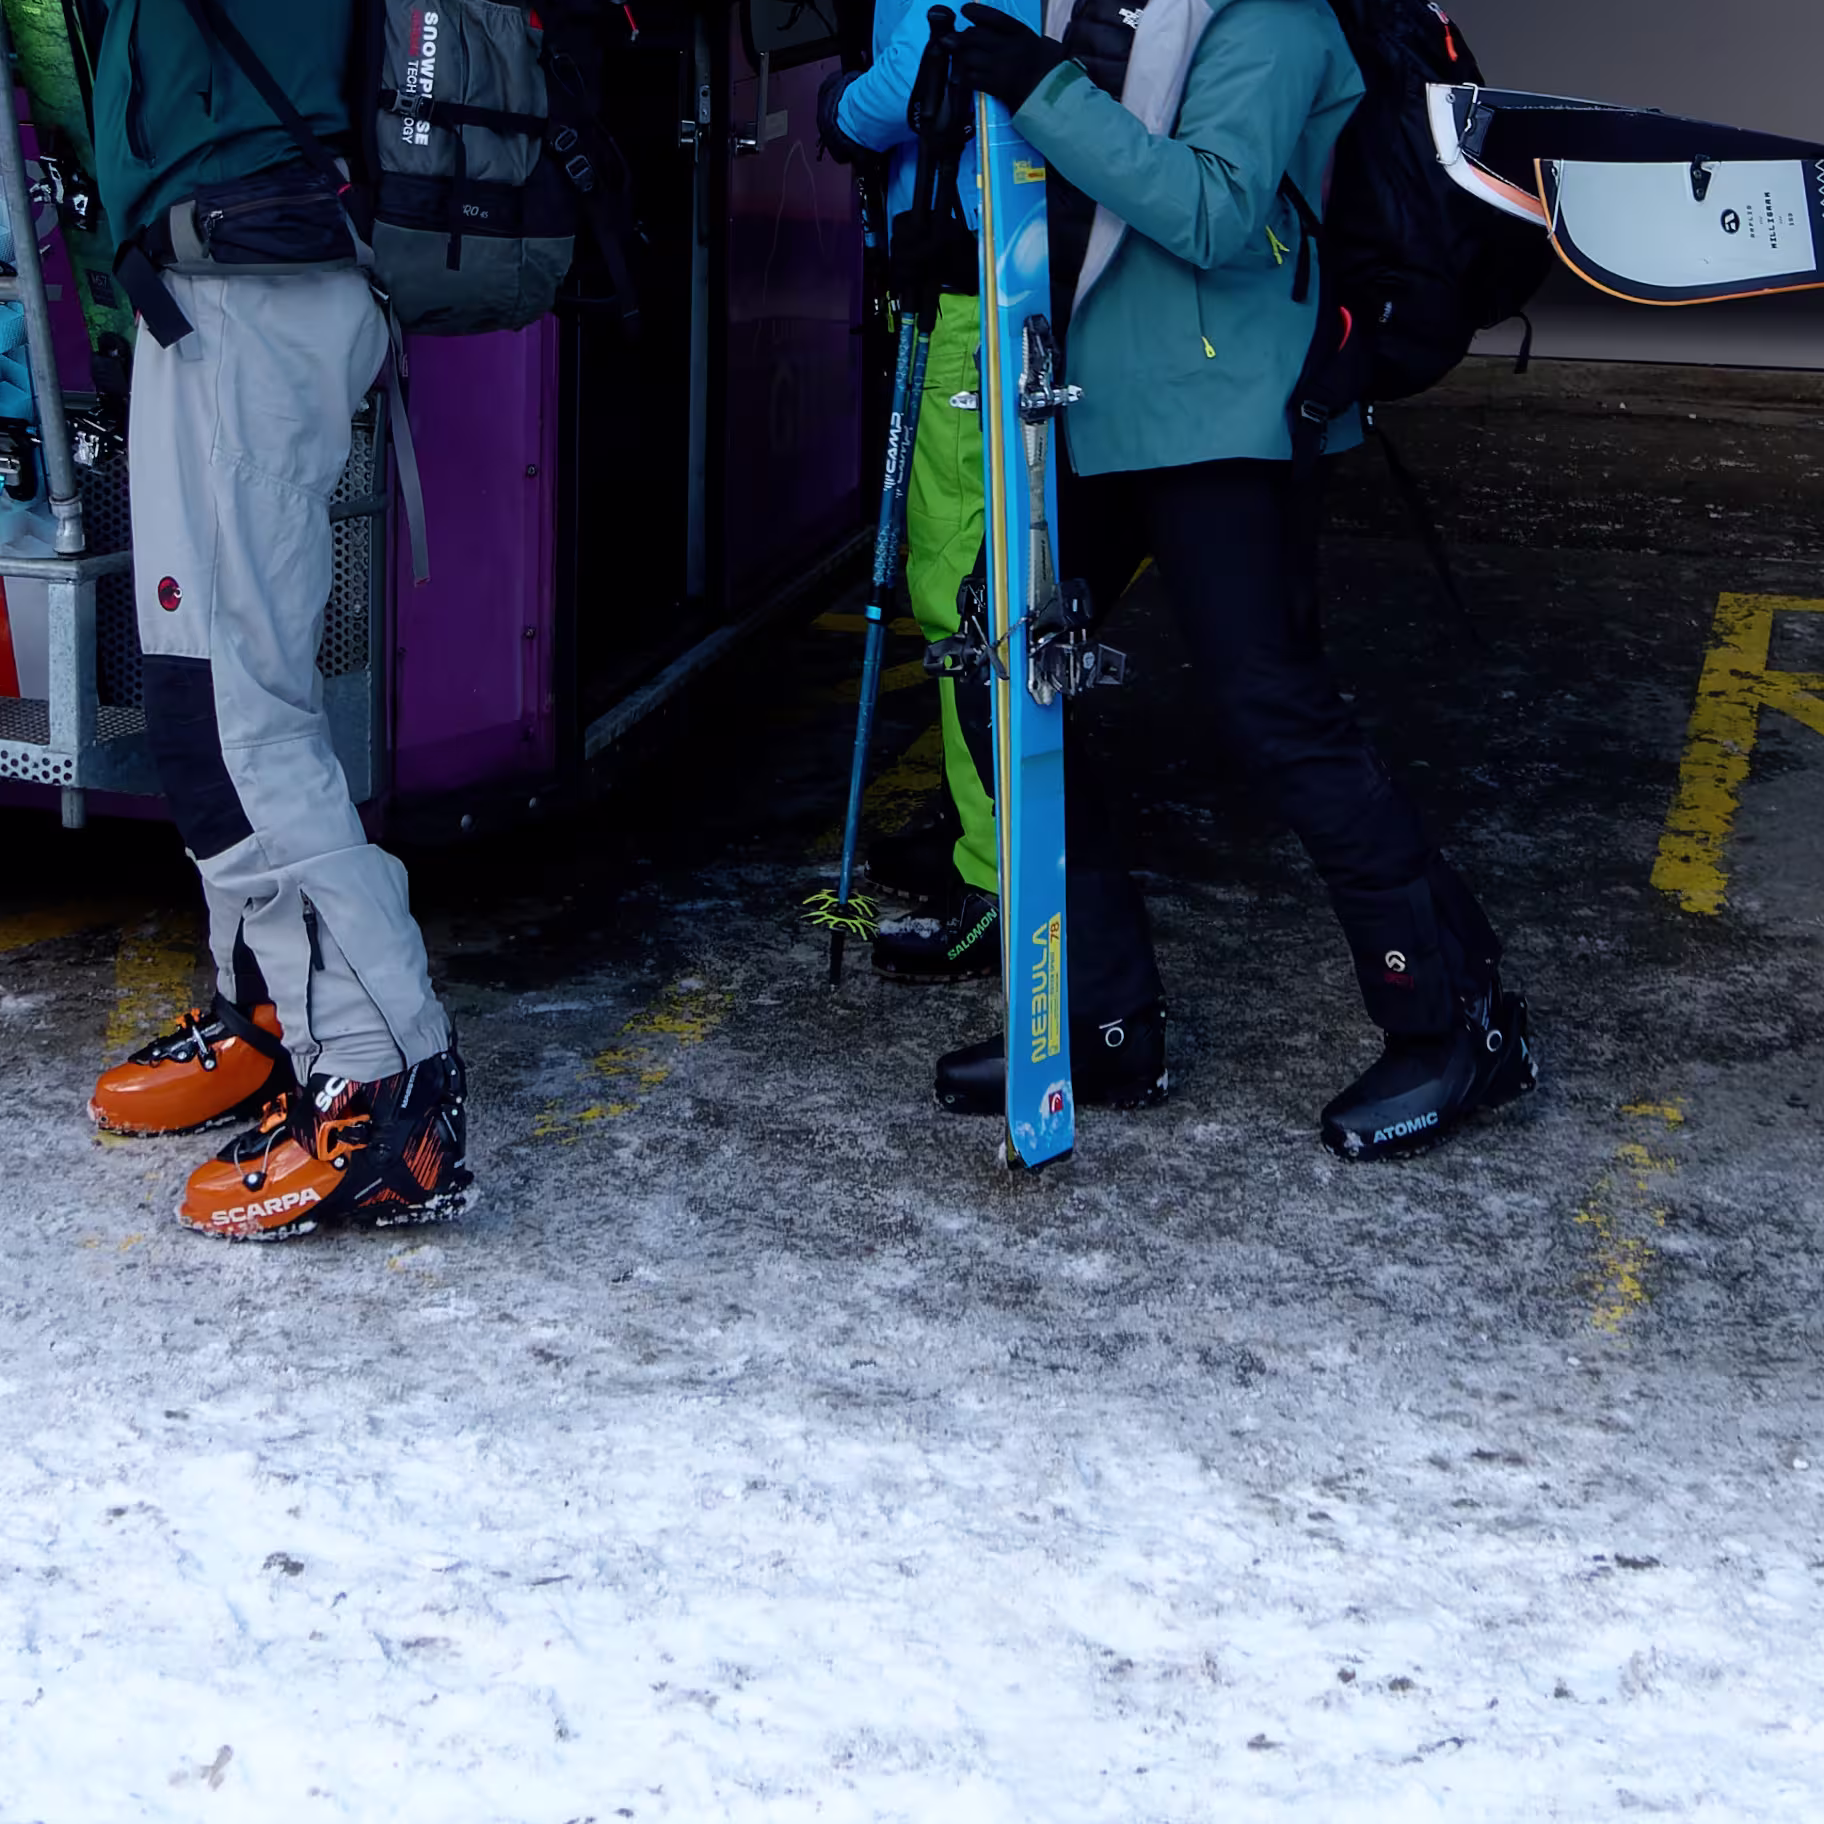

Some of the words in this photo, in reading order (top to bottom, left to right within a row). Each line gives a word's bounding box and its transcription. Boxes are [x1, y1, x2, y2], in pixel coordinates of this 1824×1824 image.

[401, 60, 419, 145] TECHOGY
[1764, 192, 1778, 249] MILLIGRAM
[947, 907, 999, 961] SALOMON
[1031, 922, 1048, 1064] NEBULA
[1373, 1110, 1439, 1144] ATOMIC
[211, 1187, 322, 1226] SCARPA
